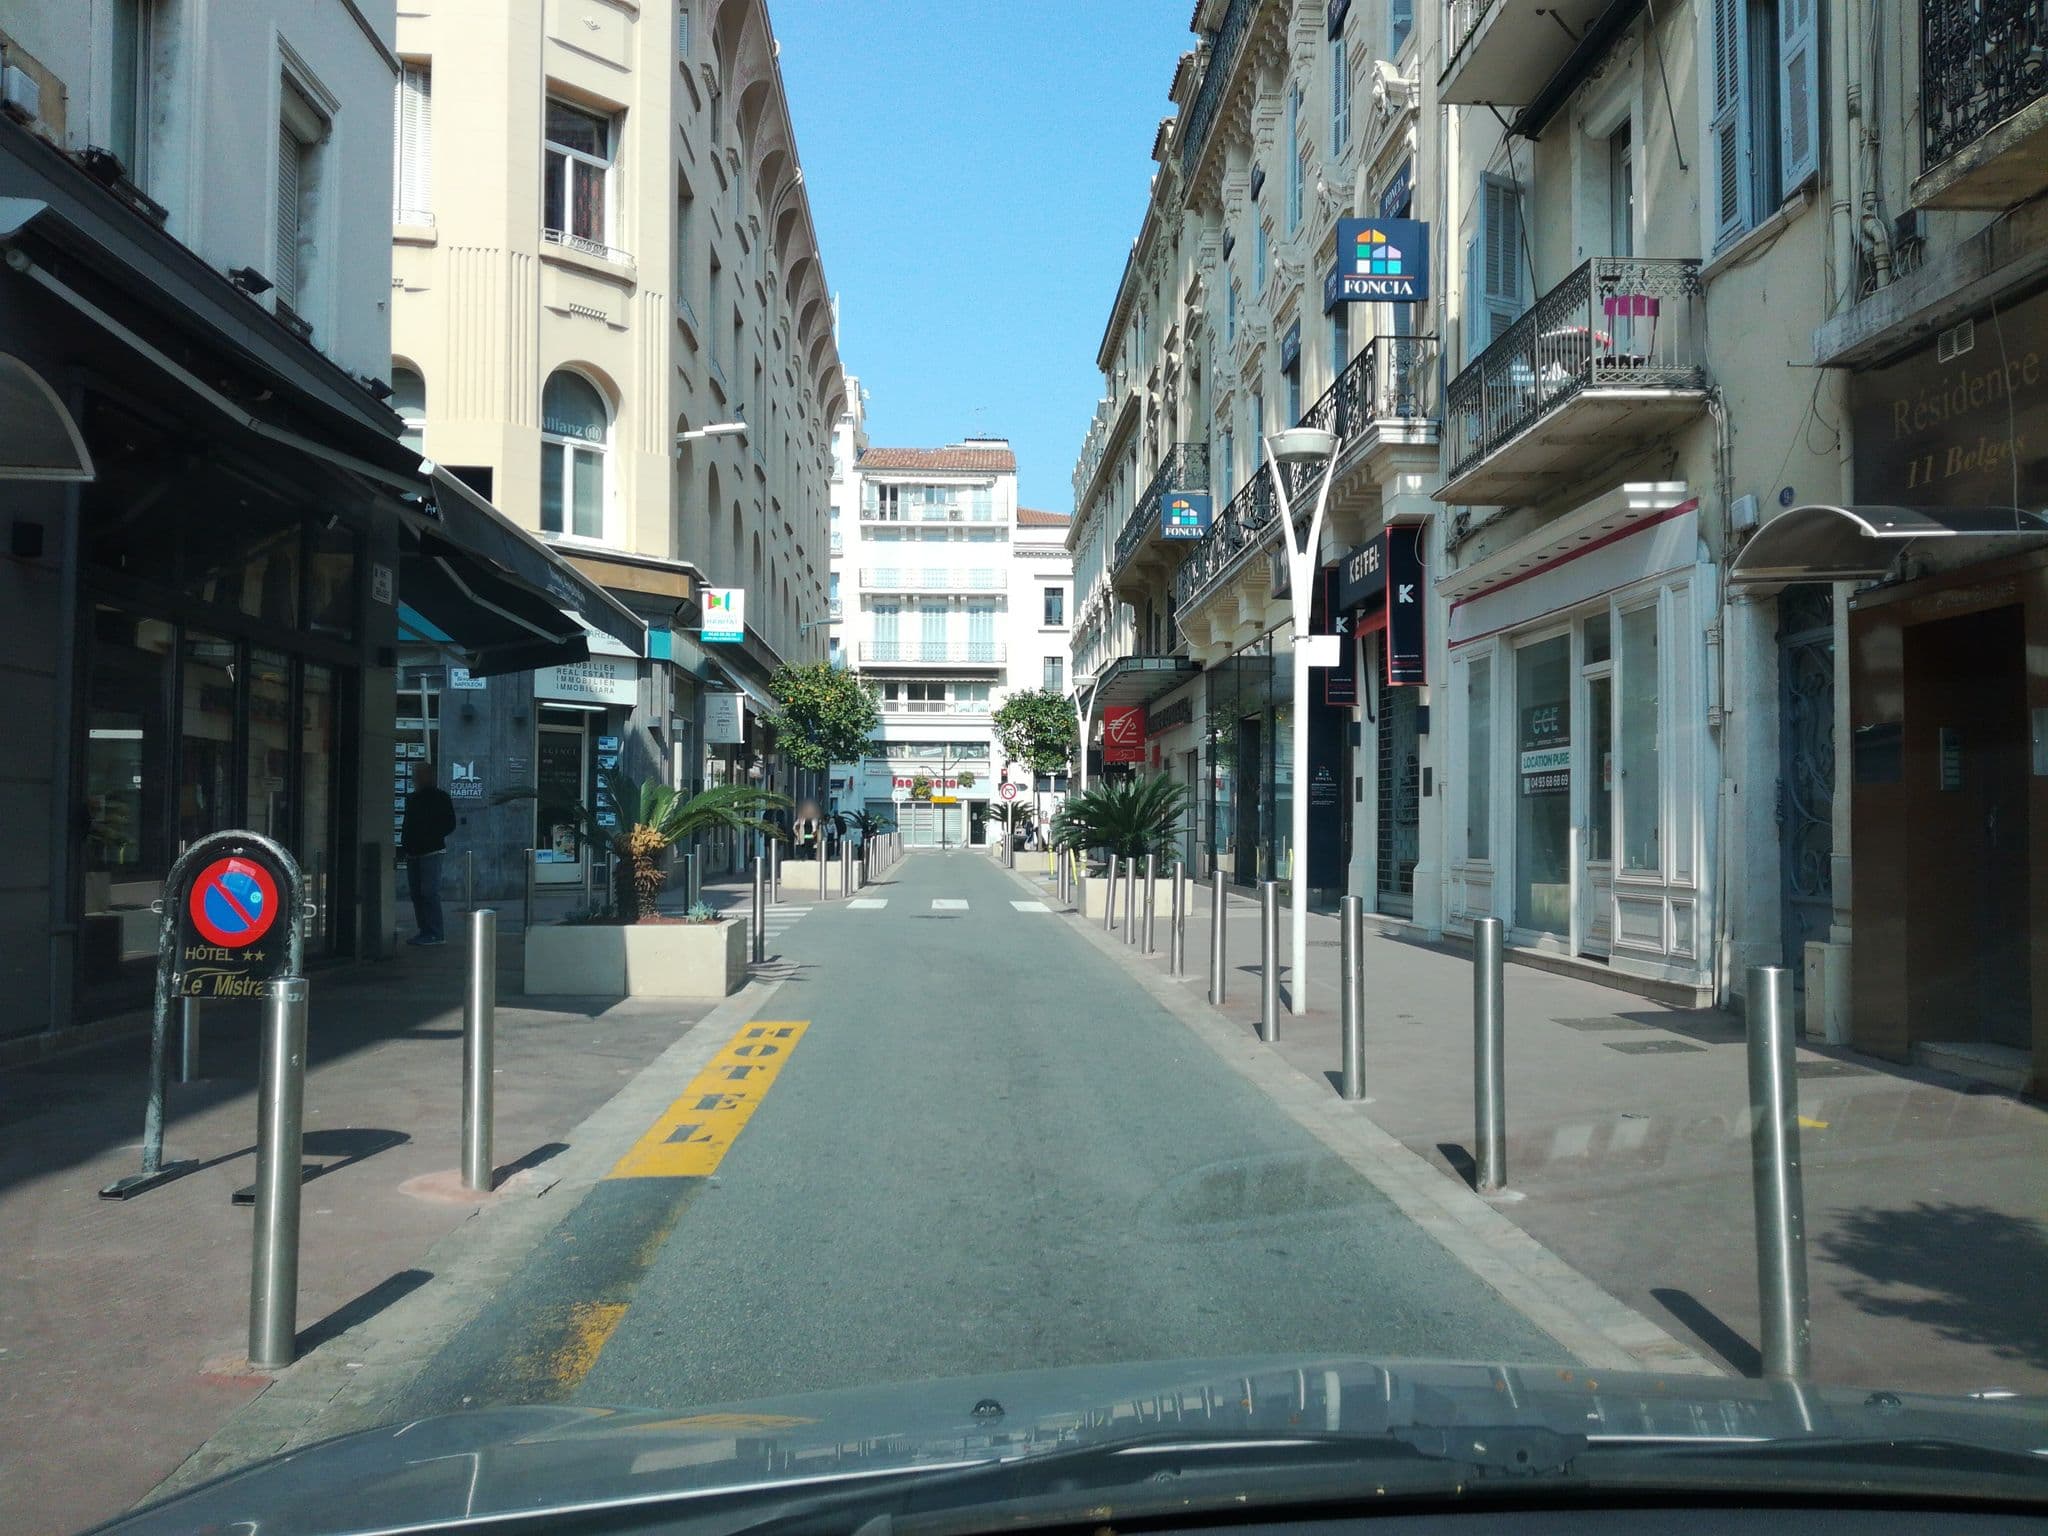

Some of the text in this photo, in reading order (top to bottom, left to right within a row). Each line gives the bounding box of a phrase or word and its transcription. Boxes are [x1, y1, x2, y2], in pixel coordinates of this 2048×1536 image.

[1344, 279, 1413, 295] FONCIA
[1892, 353, 2039, 439] Résidence
[1908, 455, 1933, 489] 11
[1165, 527, 1204, 537] FONCIA
[1349, 544, 1380, 584] KEITEL
[1398, 584, 1414, 604] K
[1335, 616, 1349, 633] K
[556, 668, 614, 679] REAL ESTATE
[556, 675, 615, 686] IMMOBILIEN
[1523, 751, 1570, 769] LOCATION PURE
[1530, 776, 1538, 789] 04
[185, 944, 234, 961] HÔTEL
[181, 974, 265, 997] Le Mistra
[660, 1027, 795, 1145] HOTEL
